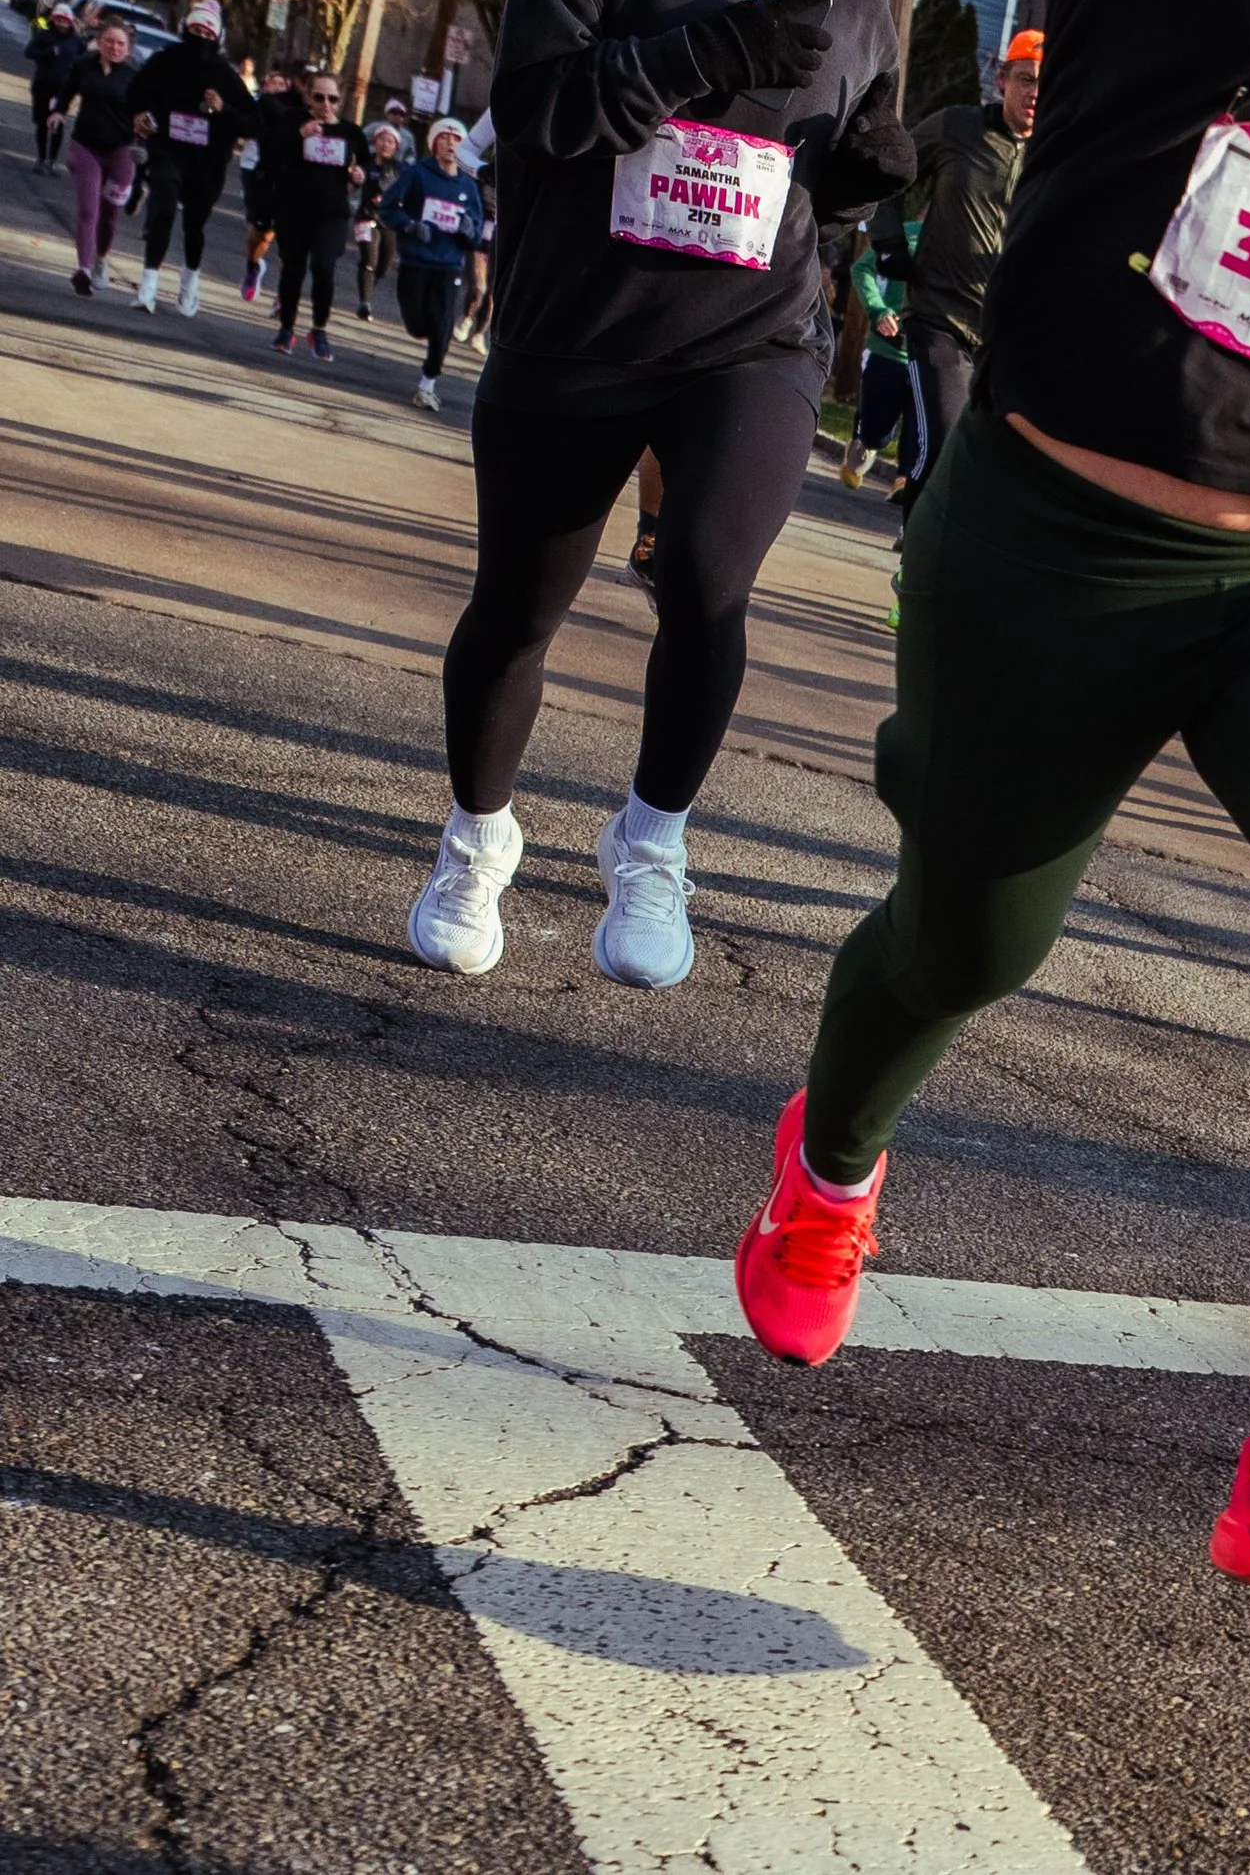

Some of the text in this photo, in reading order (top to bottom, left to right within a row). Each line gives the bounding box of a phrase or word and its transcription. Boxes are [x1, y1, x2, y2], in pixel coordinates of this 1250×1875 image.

[675, 164, 741, 187] SAMANTHA
[649, 173, 762, 219] PAWLIK
[687, 208, 722, 227] 2179
[668, 227, 692, 237] MAX
